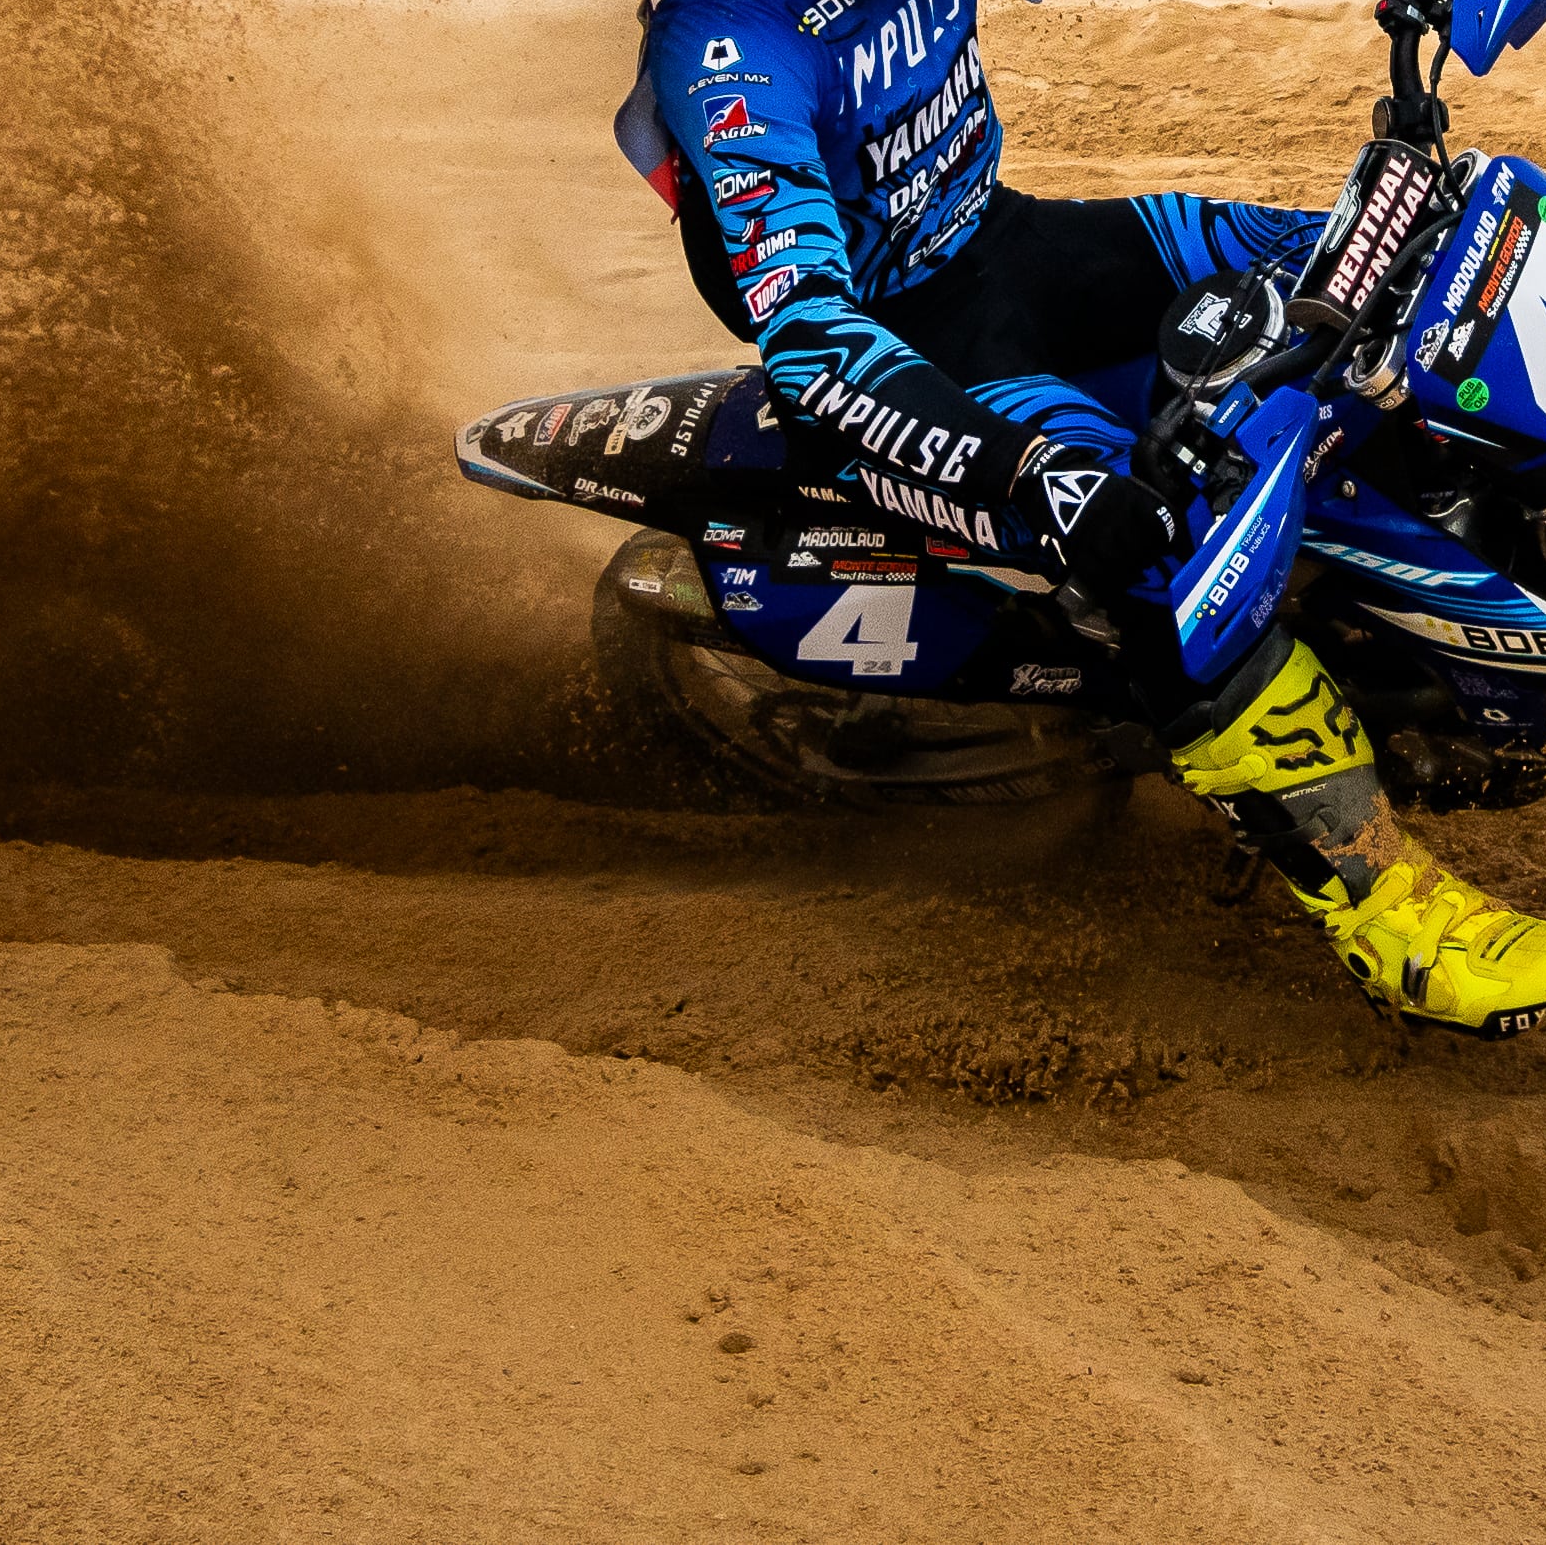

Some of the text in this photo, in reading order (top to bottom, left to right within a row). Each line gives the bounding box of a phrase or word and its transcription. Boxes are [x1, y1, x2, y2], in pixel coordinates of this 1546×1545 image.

[744, 72, 771, 85] MX
[866, 36, 980, 182] YAMAHA
[1492, 162, 1515, 206] FIM
[1327, 156, 1412, 304] RENTHAL
[1351, 170, 1433, 311] RENTHAL
[1442, 210, 1497, 315] MADOULAUD
[1478, 260, 1506, 313] MONTE
[1499, 215, 1524, 262] GORDO
[753, 269, 791, 316] 100%
[1486, 288, 1506, 319] Sand
[1458, 381, 1476, 399] PUB
[1473, 395, 1488, 408] OK
[670, 383, 718, 457] IMPULSE
[799, 372, 982, 483] IMPULSE
[575, 478, 645, 506] DRAGON
[704, 529, 745, 542] DOMA
[798, 532, 886, 547] MADOULAUD
[1241, 515, 1264, 547] TRAVAUX
[722, 567, 757, 586] FIM
[830, 571, 857, 581] Sand
[1209, 552, 1250, 606] BOB
[797, 585, 918, 675] 4
[863, 660, 893, 672] 24
[1282, 783, 1327, 800] INSTINCT
